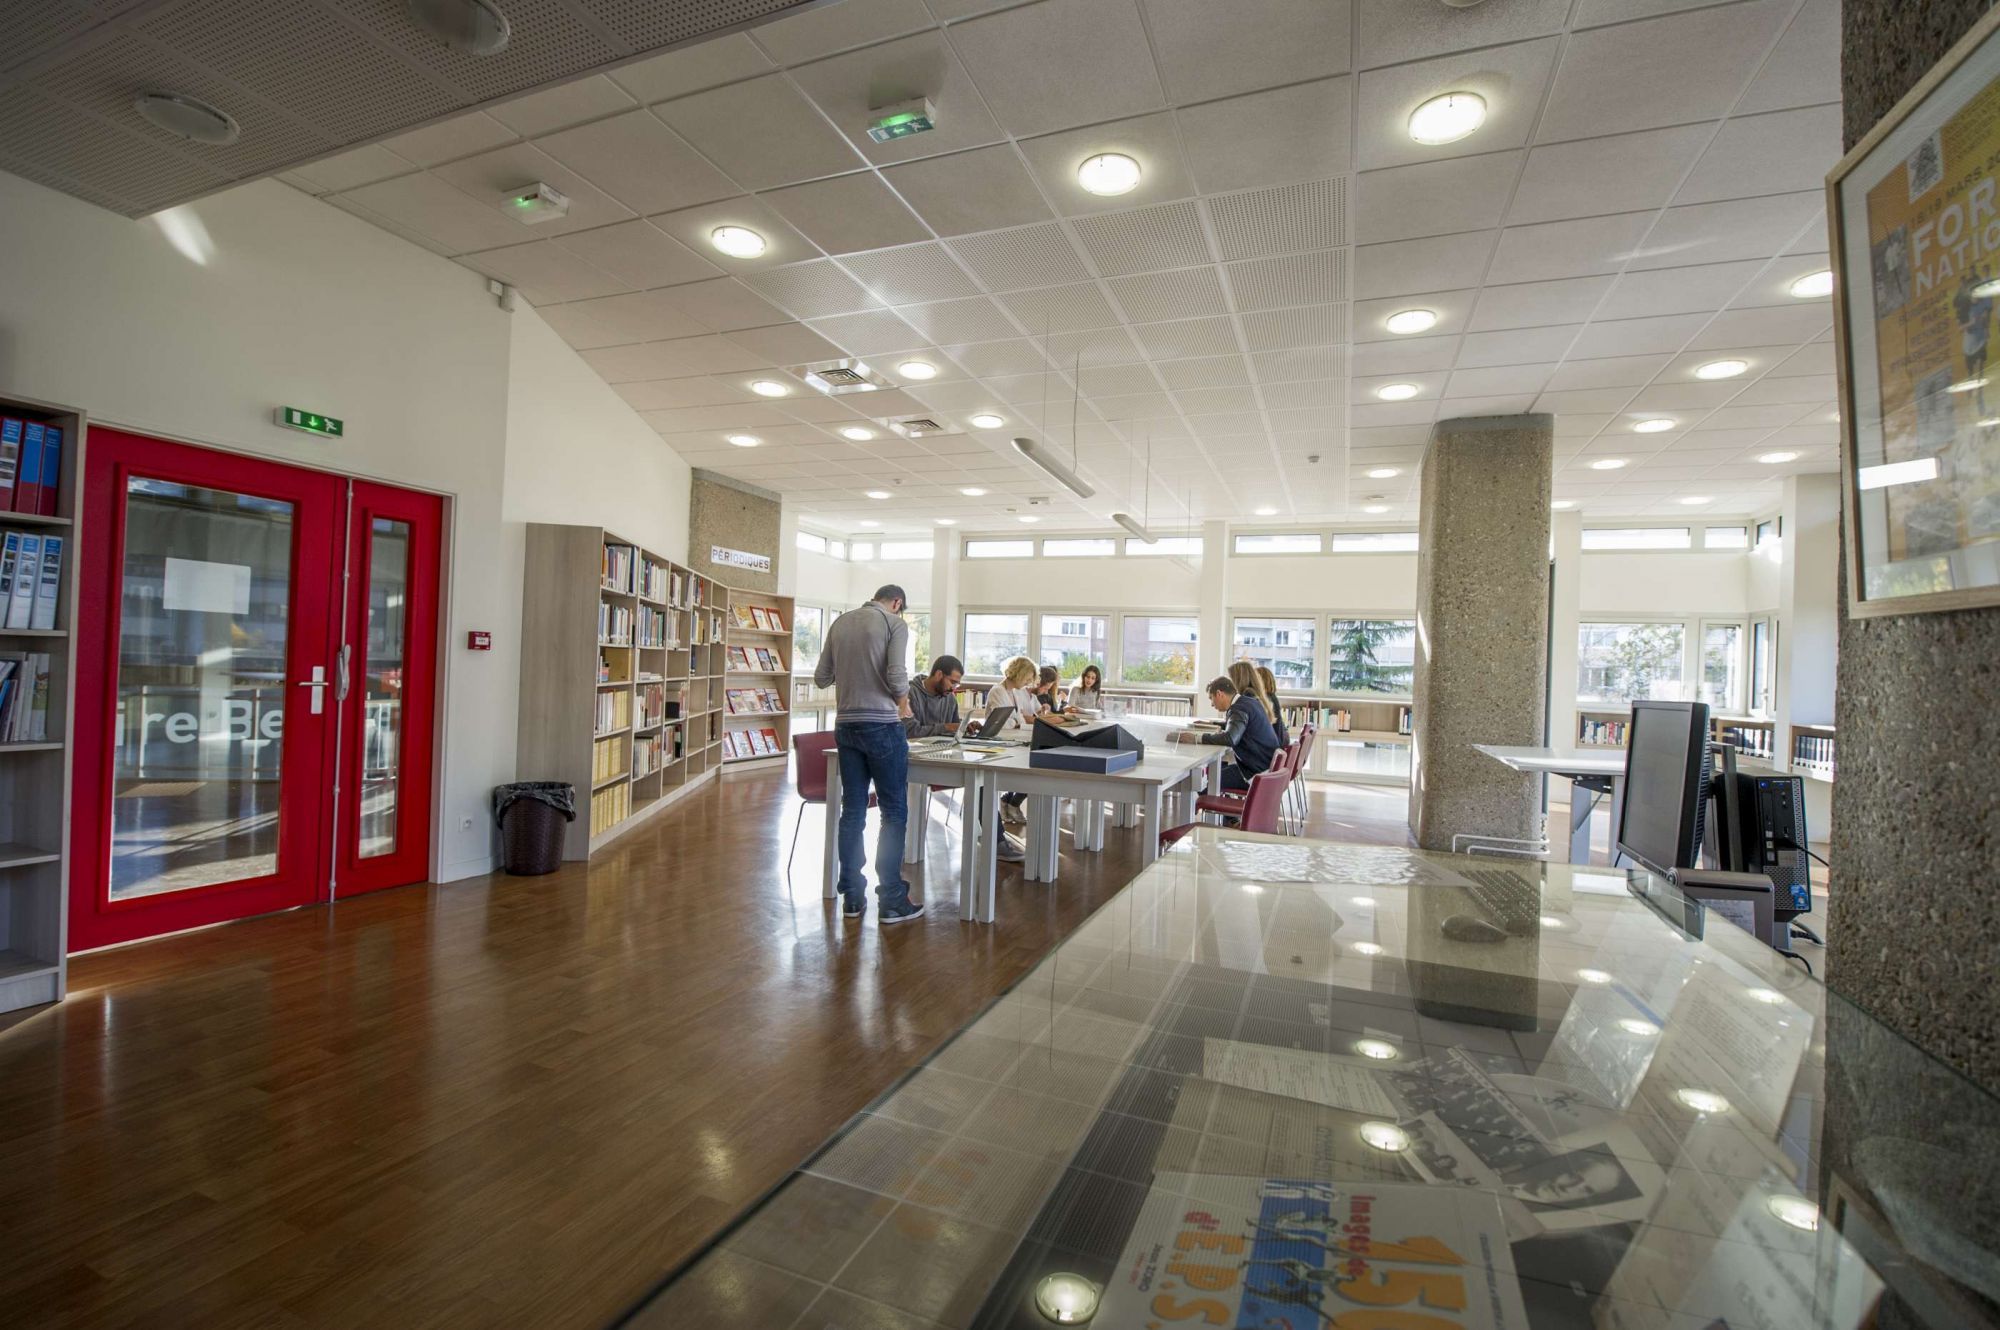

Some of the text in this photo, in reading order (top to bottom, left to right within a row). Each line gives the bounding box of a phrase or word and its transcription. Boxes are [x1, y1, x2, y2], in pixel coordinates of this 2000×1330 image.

[1946, 165, 1982, 200] MARS
[1912, 176, 1997, 269] FOR
[712, 548, 769, 569] PÉRIODIQUES
[1342, 1195, 1377, 1253] Images
